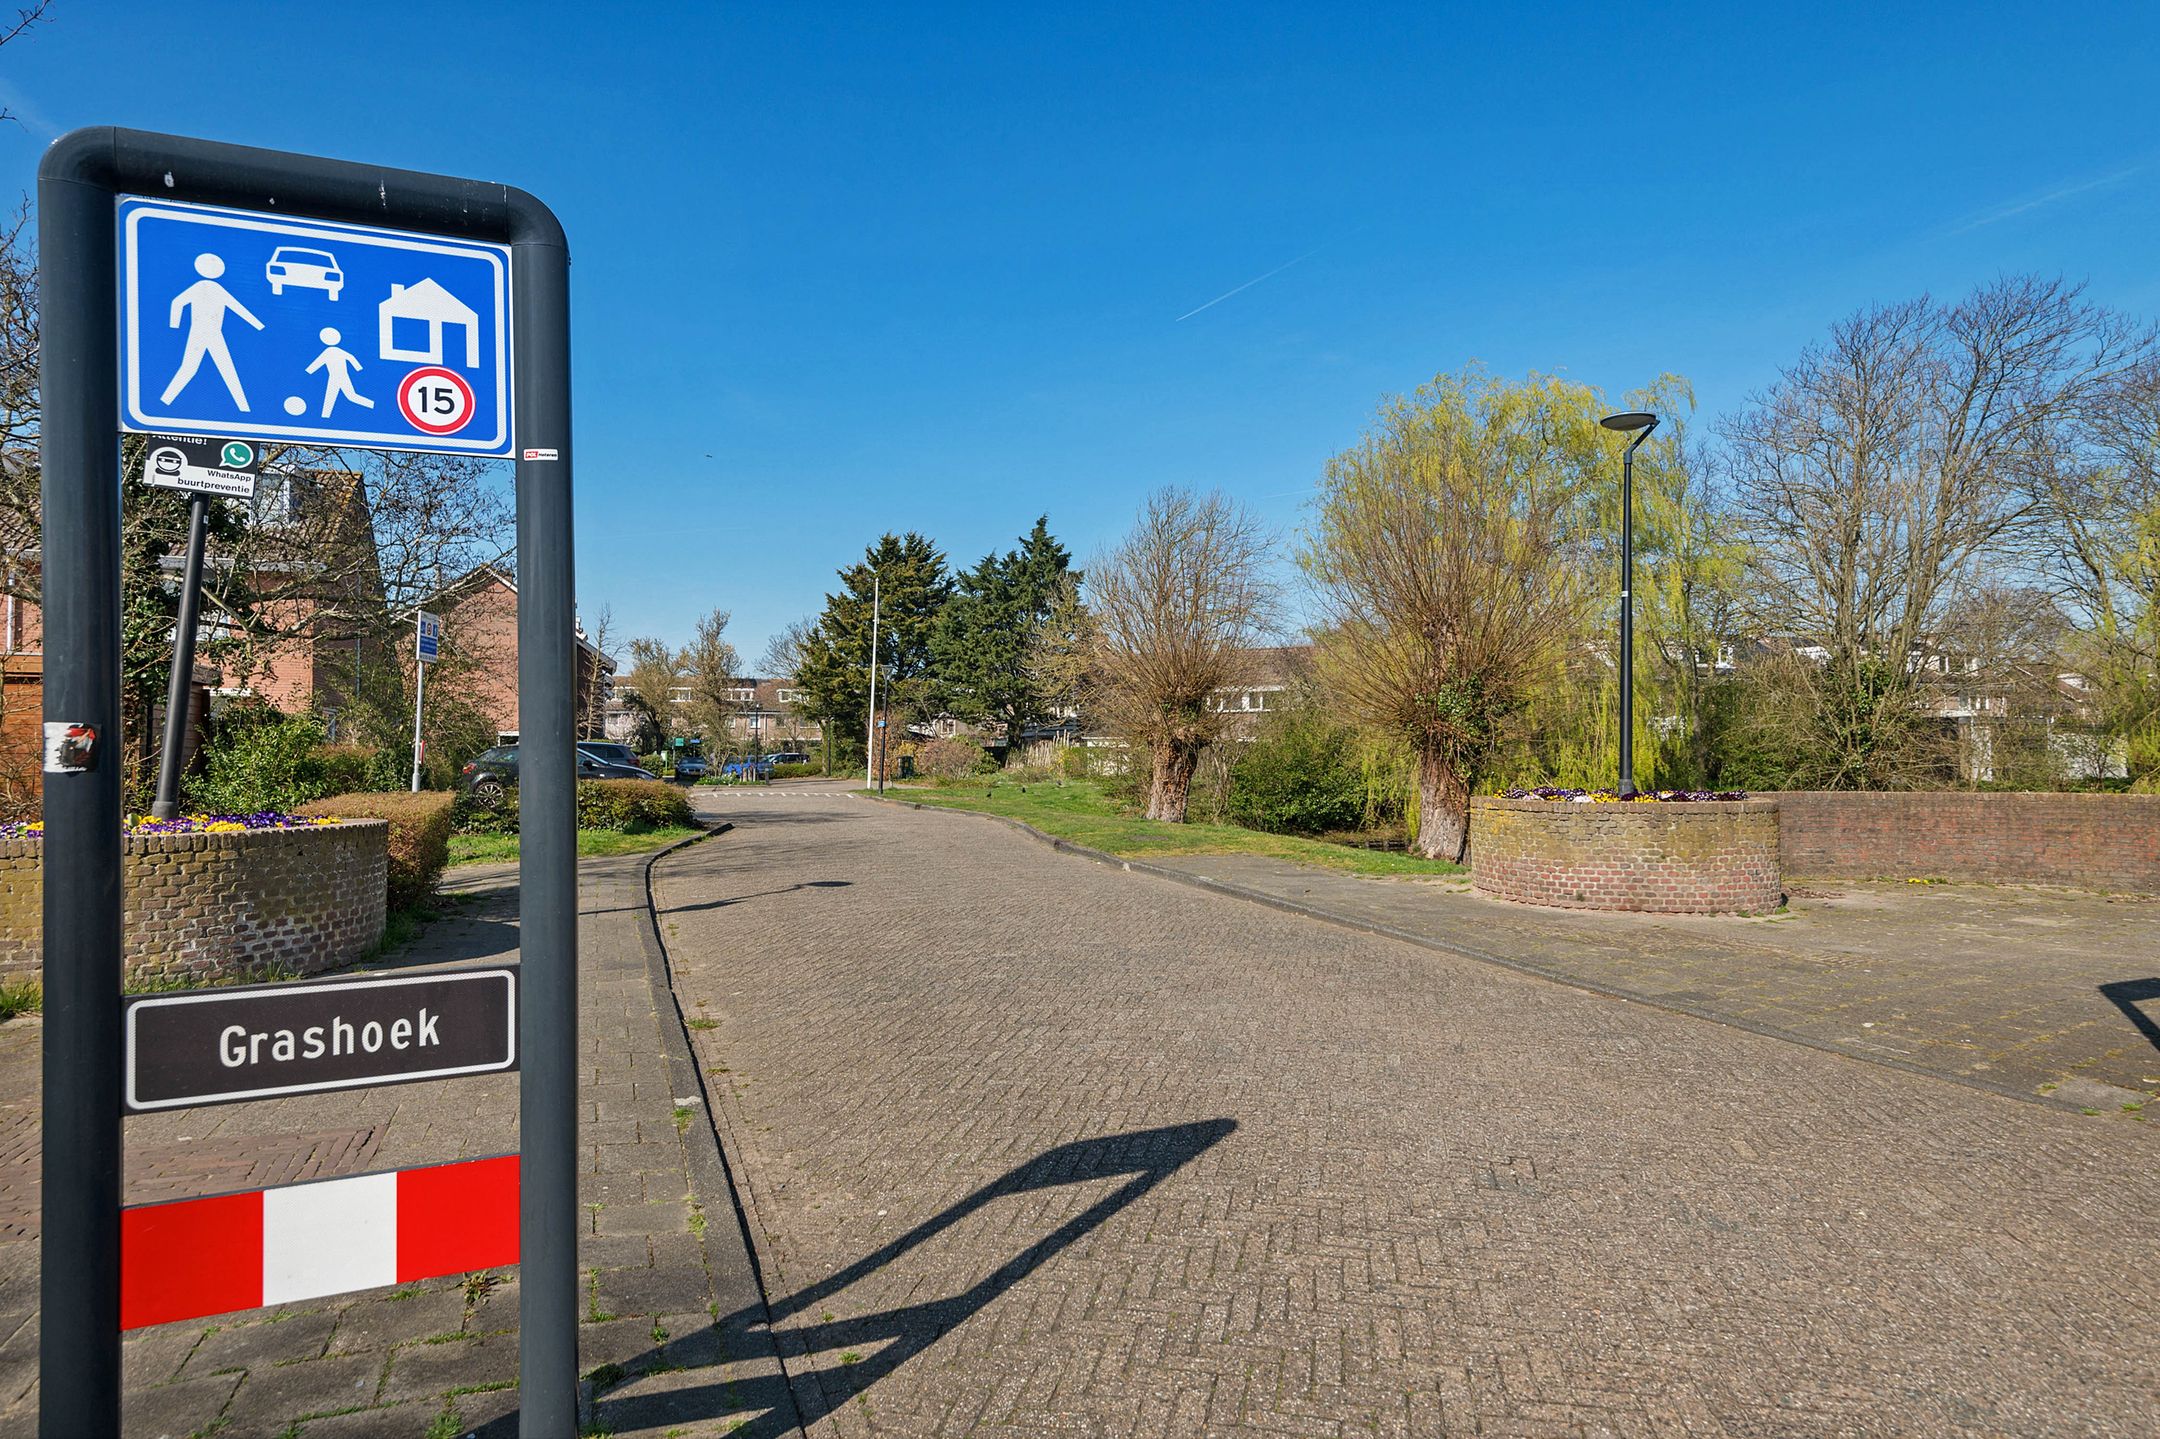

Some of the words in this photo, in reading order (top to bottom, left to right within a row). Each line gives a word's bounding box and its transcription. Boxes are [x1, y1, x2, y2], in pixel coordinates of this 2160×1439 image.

[418, 386, 455, 415] 15
[152, 434, 208, 446] entie!
[207, 469, 251, 482] WhatsApp
[177, 477, 250, 494] buurtpreventie
[219, 1007, 440, 1068] Grashoek
